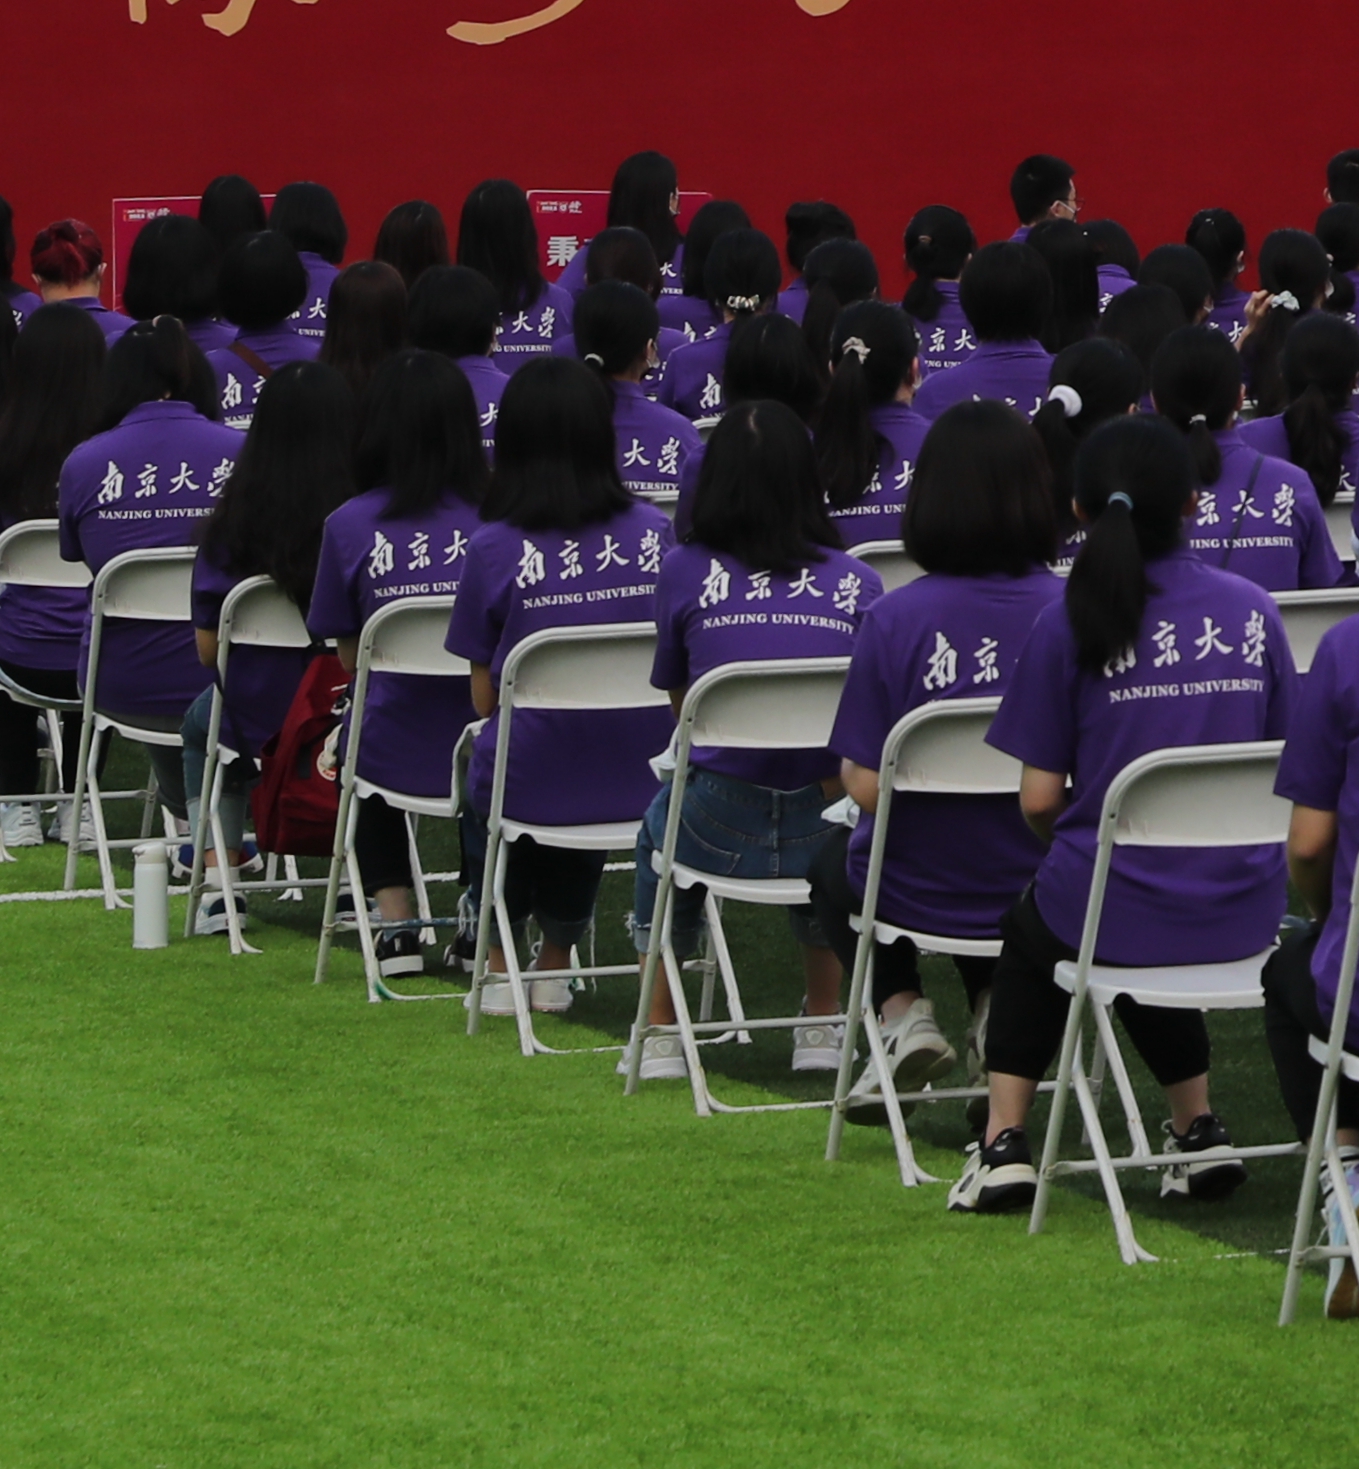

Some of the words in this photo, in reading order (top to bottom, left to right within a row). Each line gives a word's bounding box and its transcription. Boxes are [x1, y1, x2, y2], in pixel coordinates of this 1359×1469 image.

[624, 437, 679, 474] 大學
[99, 510, 151, 519] NANJING
[1197, 484, 1294, 526] 京大學
[369, 530, 467, 578] 南京大
[523, 593, 583, 608] NANJING
[699, 556, 861, 616] 南京大學
[704, 614, 767, 628] NANJING
[772, 611, 854, 634] UNIVERSITY
[1110, 684, 1179, 702] NANJING
[1183, 679, 1262, 695] UNIVERSITY
